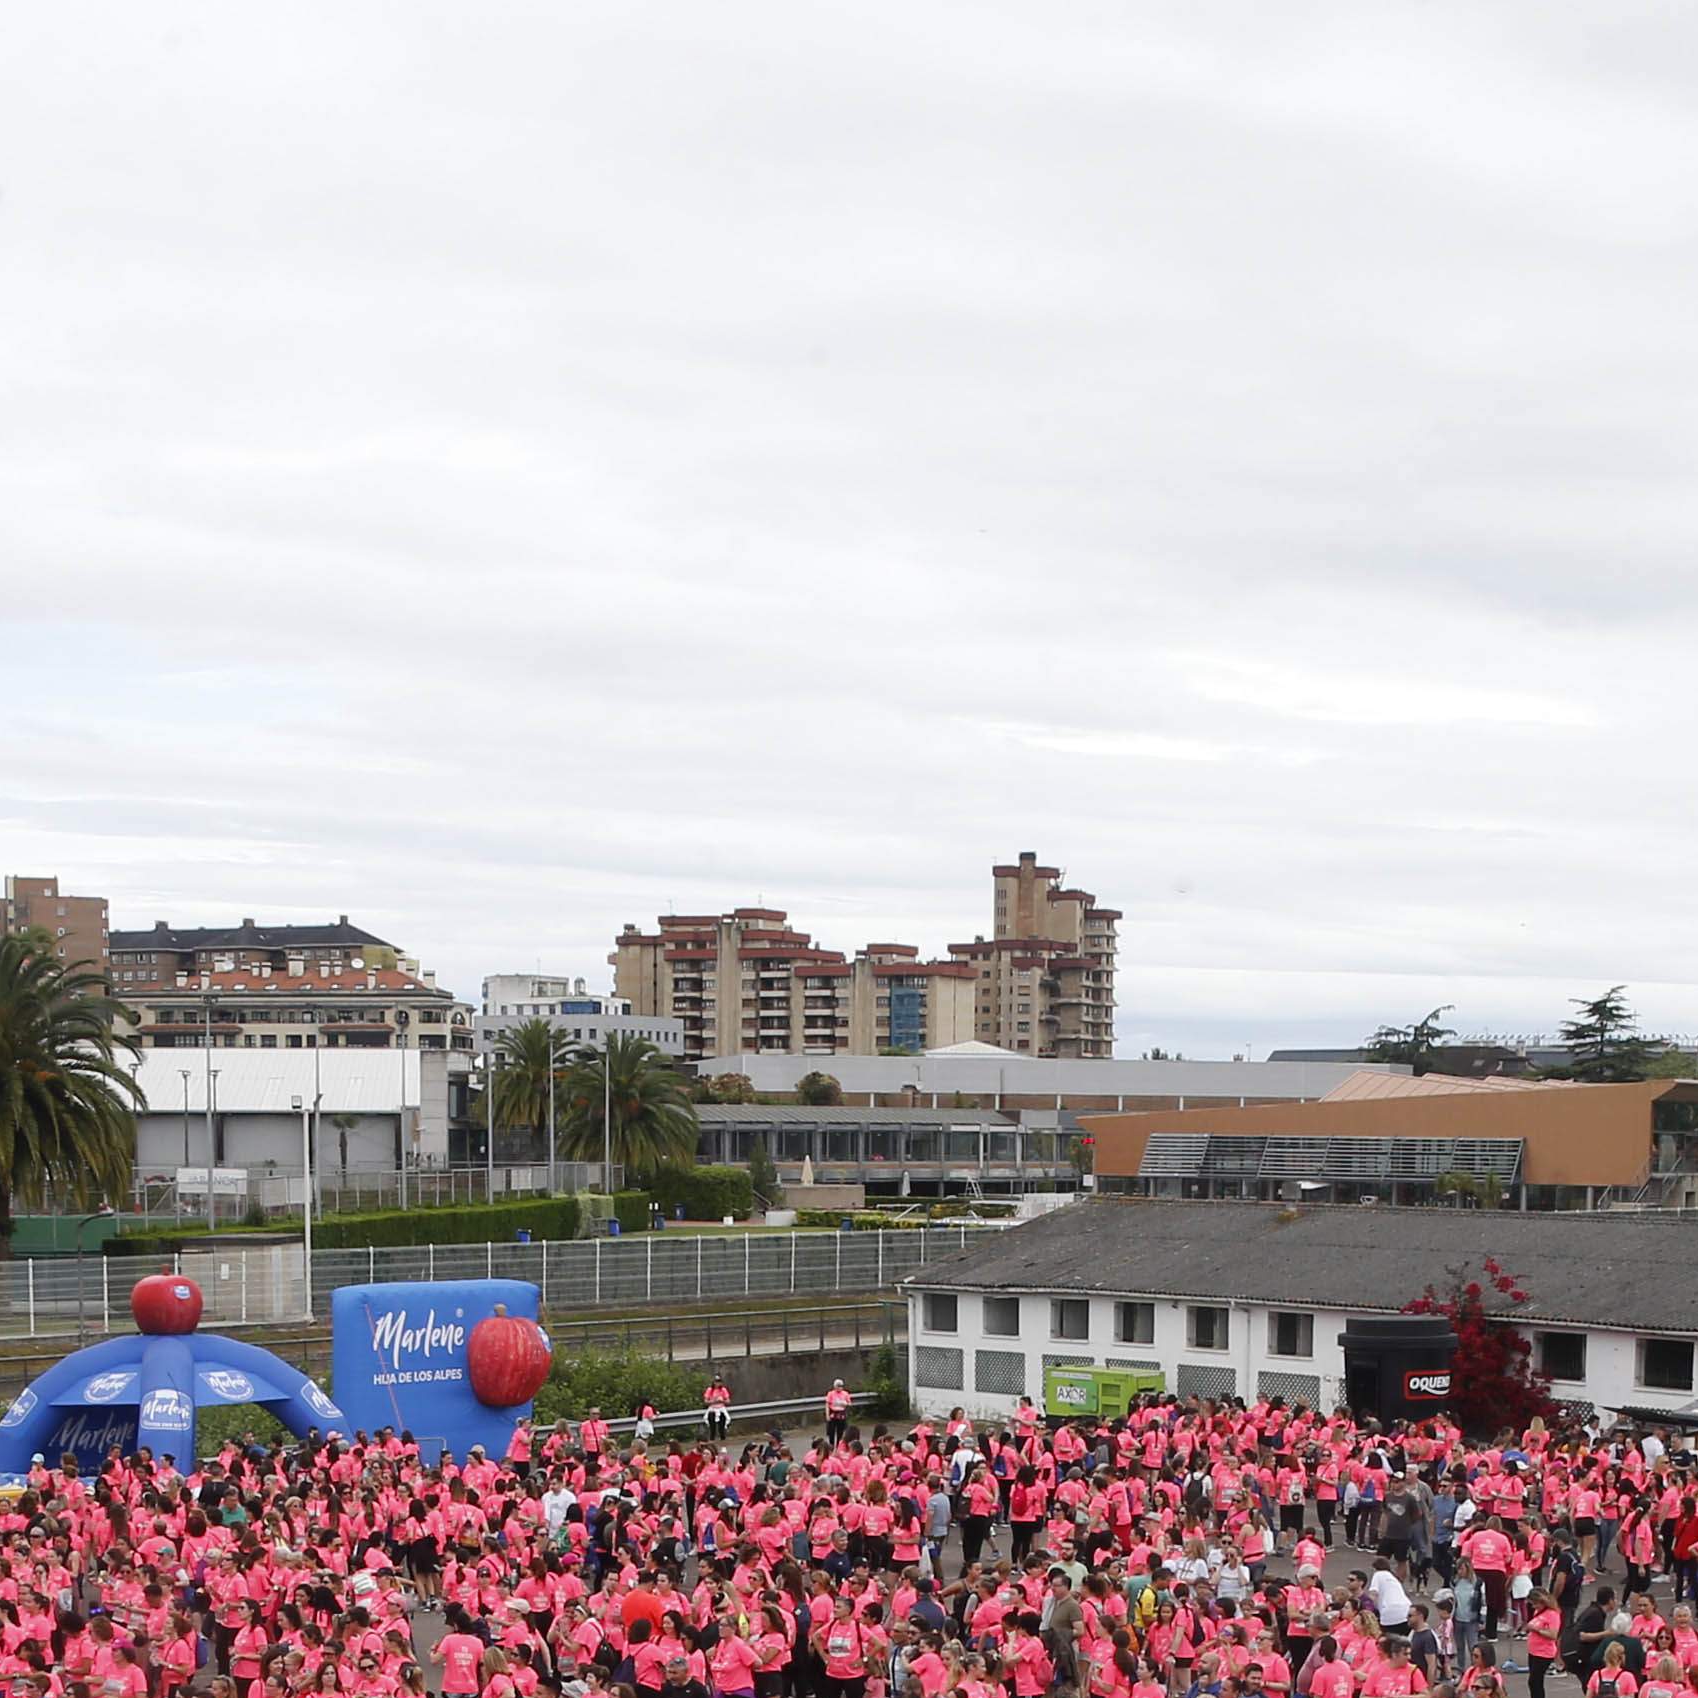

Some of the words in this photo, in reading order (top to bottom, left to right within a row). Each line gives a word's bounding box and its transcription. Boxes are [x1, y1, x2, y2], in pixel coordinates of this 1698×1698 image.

[373, 1310, 464, 1369] Marlene
[400, 1373, 413, 1384] DE
[414, 1371, 435, 1383] LOS
[436, 1368, 463, 1382] ALPES
[142, 1399, 191, 1421] Marlene
[48, 1412, 135, 1454] Marlene
